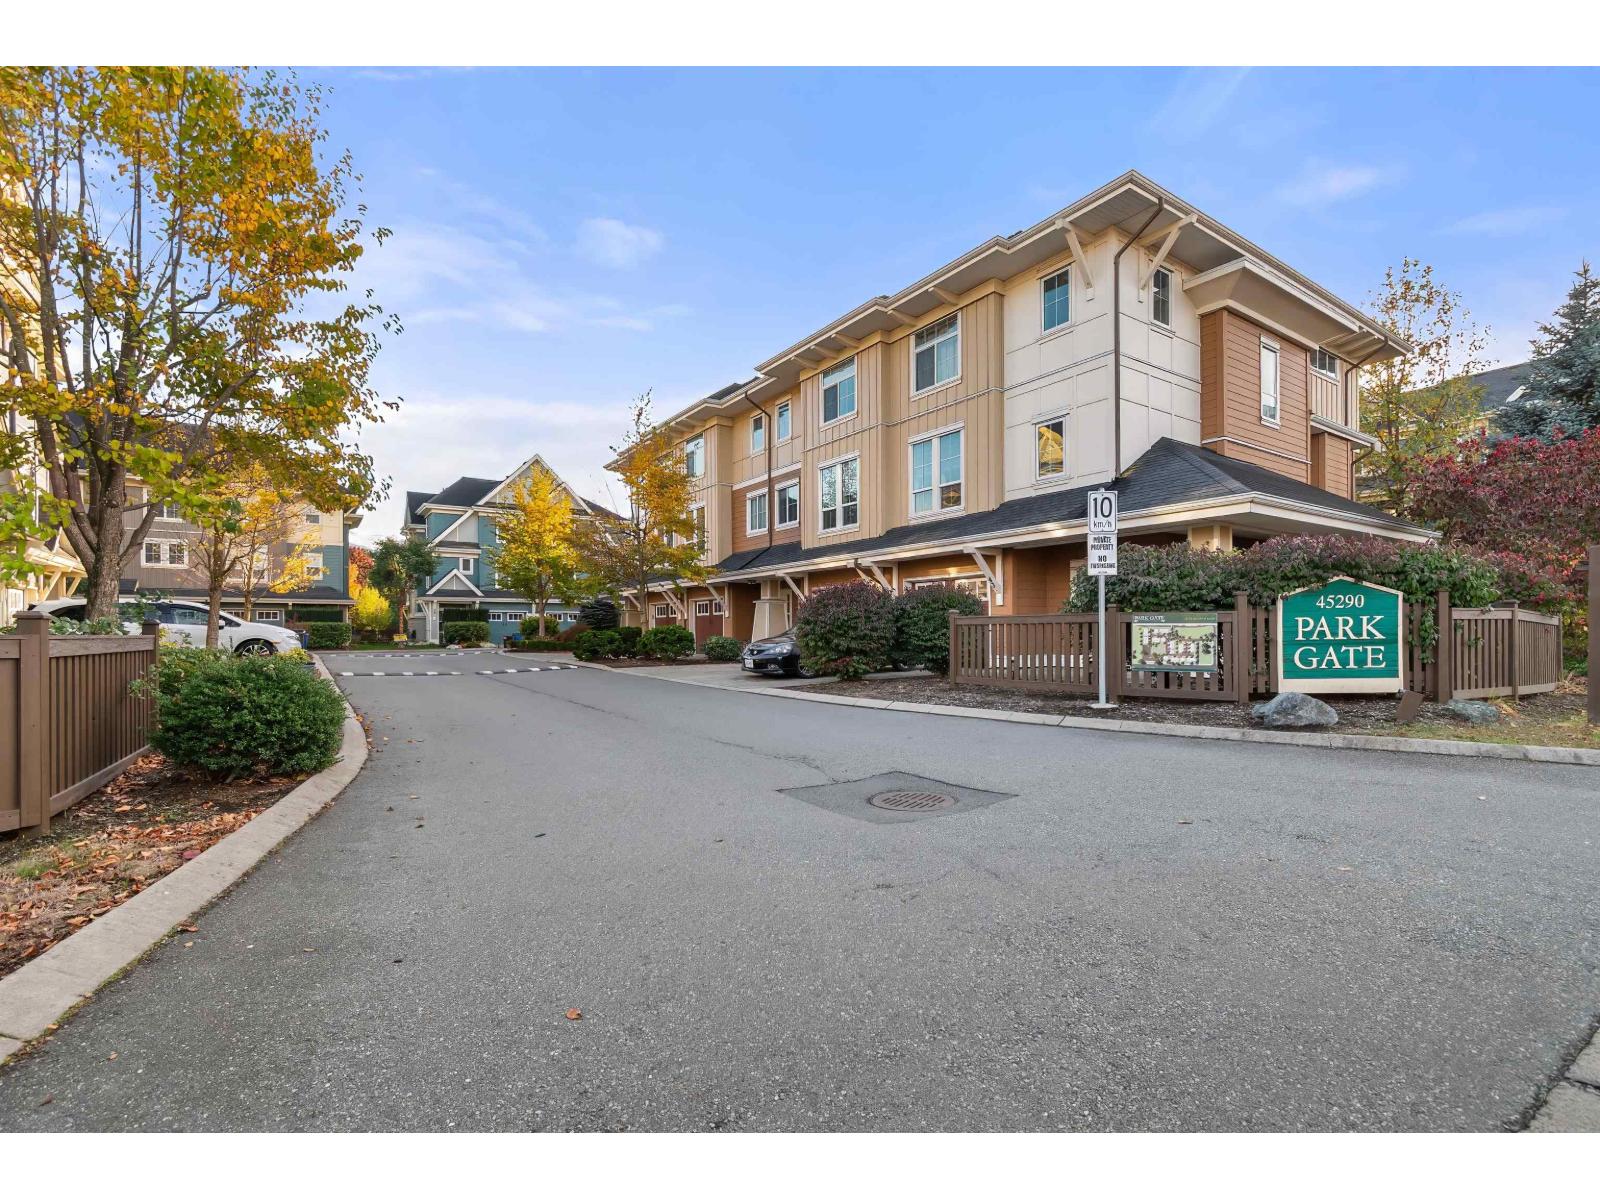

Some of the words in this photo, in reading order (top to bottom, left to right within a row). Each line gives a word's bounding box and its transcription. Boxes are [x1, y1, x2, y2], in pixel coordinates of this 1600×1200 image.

[1093, 497, 1112, 518] 10
[1093, 520, 1112, 528] km/h
[1316, 594, 1365, 609] 45290
[1294, 615, 1386, 640] PARK
[1293, 645, 1386, 670] GATE
